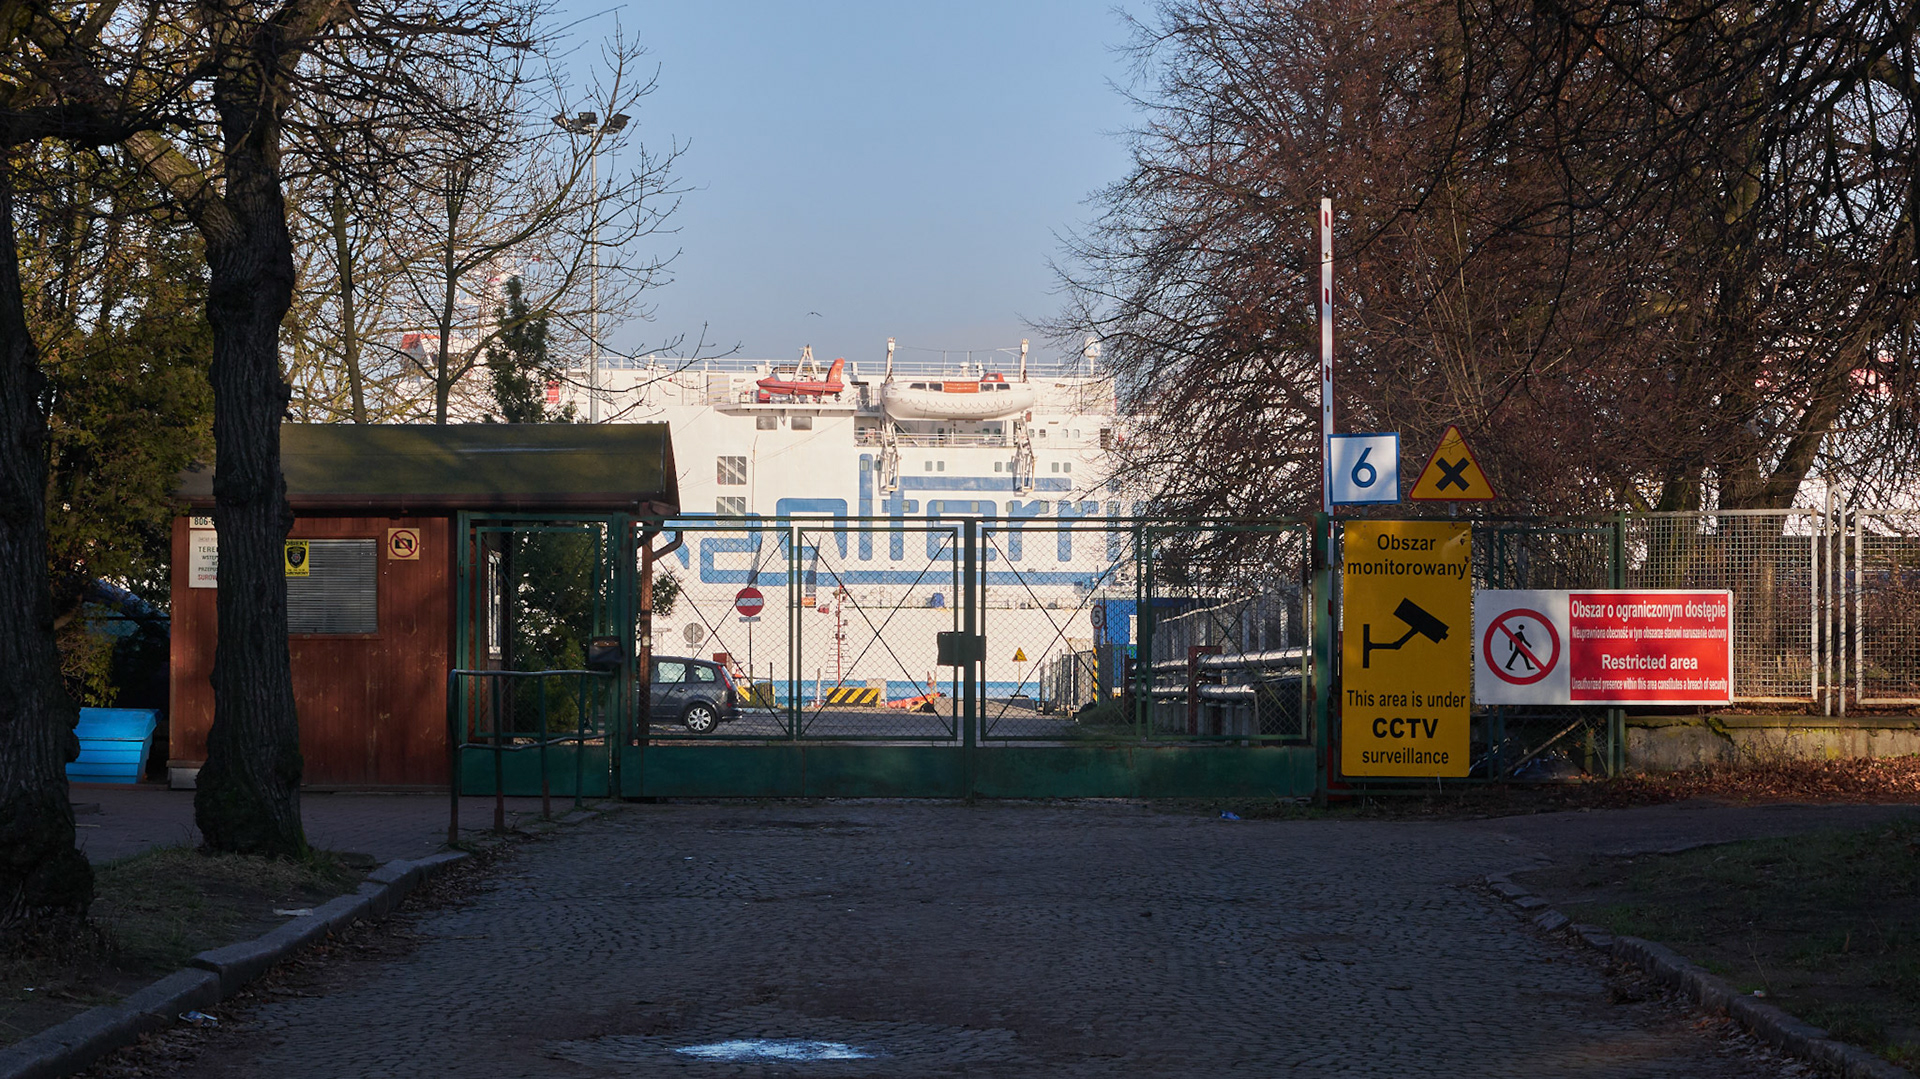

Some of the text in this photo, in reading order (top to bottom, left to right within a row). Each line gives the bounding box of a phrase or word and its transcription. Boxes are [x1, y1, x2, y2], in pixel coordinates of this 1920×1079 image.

[1351, 447, 1377, 488] 6
[1377, 533, 1436, 551] Obszar
[1347, 558, 1467, 580] monitorowany
[1093, 611, 1101, 625] 5
[1571, 600, 1726, 622] Obszar o ograniczonym dostępie
[1602, 654, 1698, 669] Restricted area
[1346, 690, 1466, 708] This area is under
[1372, 717, 1439, 739] CCTV
[1362, 747, 1449, 764] surveillance
